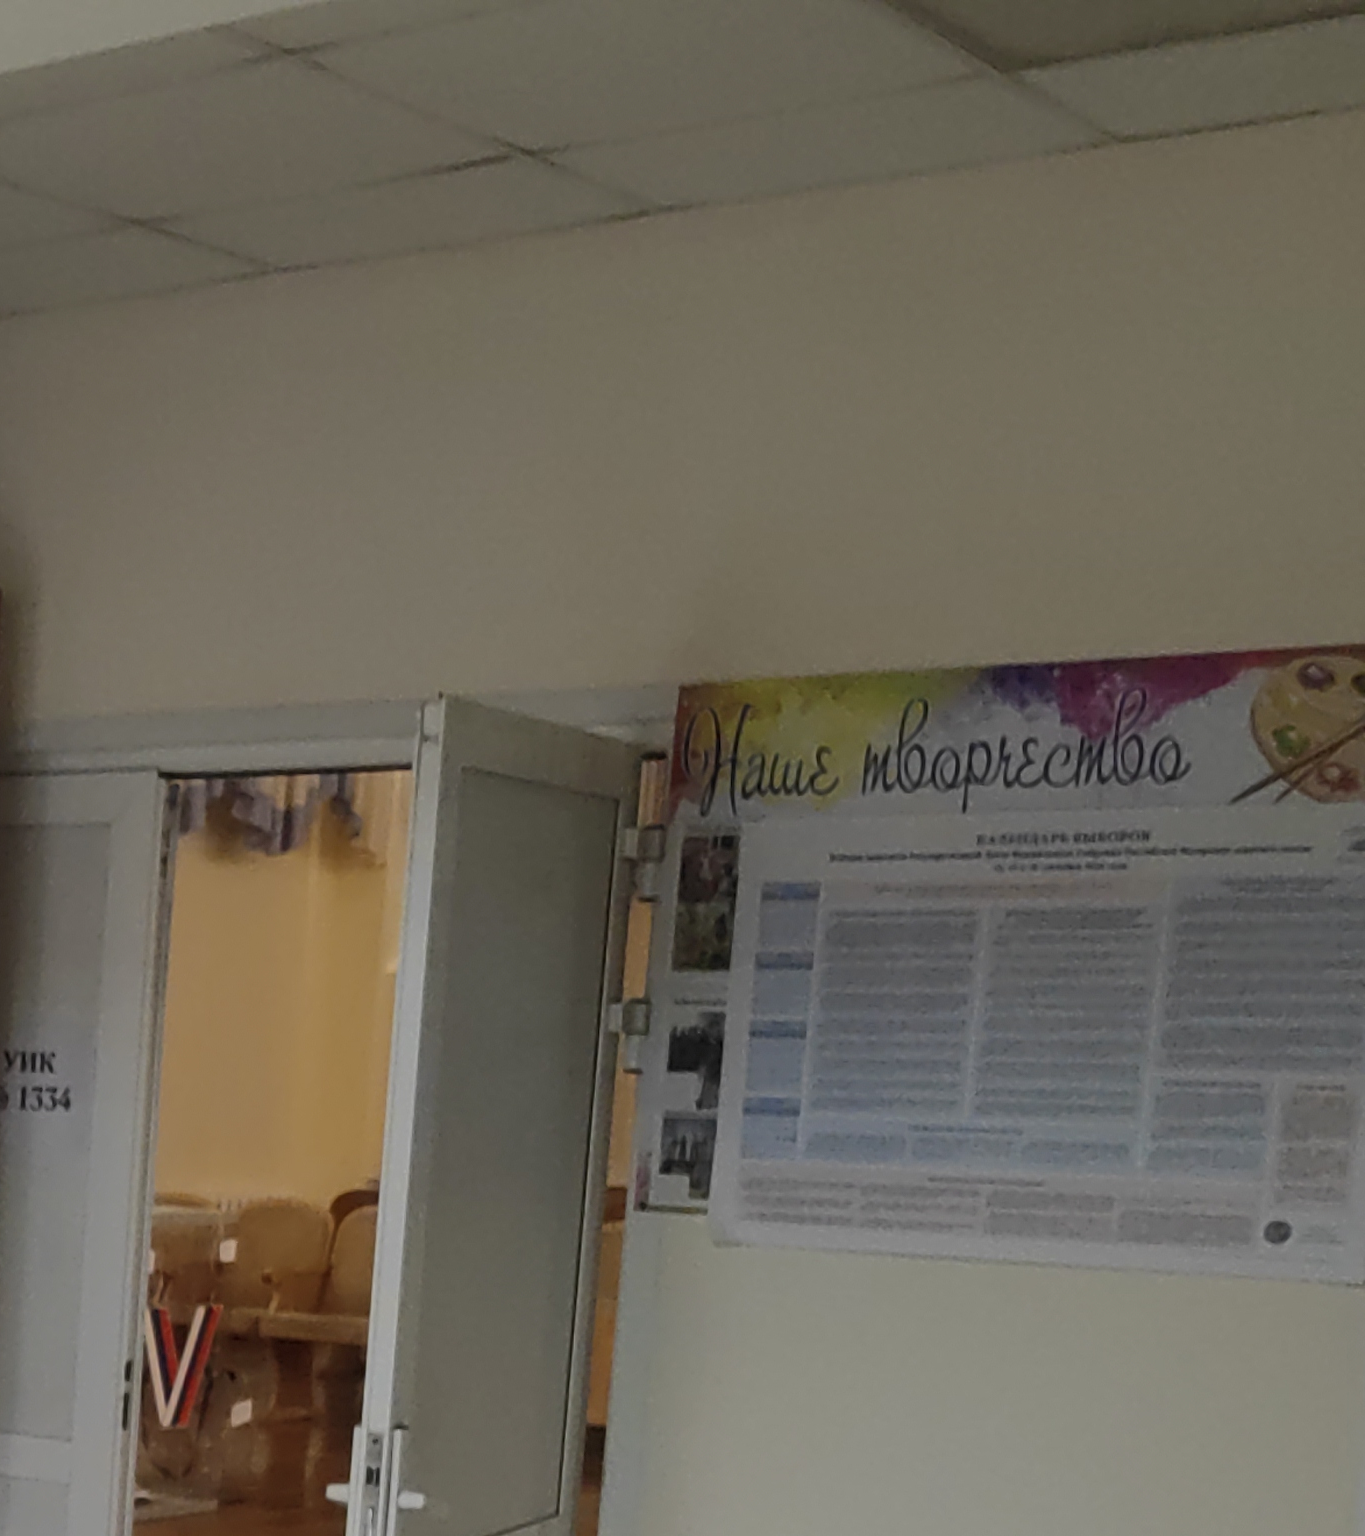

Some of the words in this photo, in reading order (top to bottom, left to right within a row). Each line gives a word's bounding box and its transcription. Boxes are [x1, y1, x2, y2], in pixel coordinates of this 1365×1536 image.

[682, 704, 840, 817] Наше
[862, 688, 1191, 814] творчество
[3, 1048, 56, 1074] УИК
[20, 1085, 72, 1112] 1334
